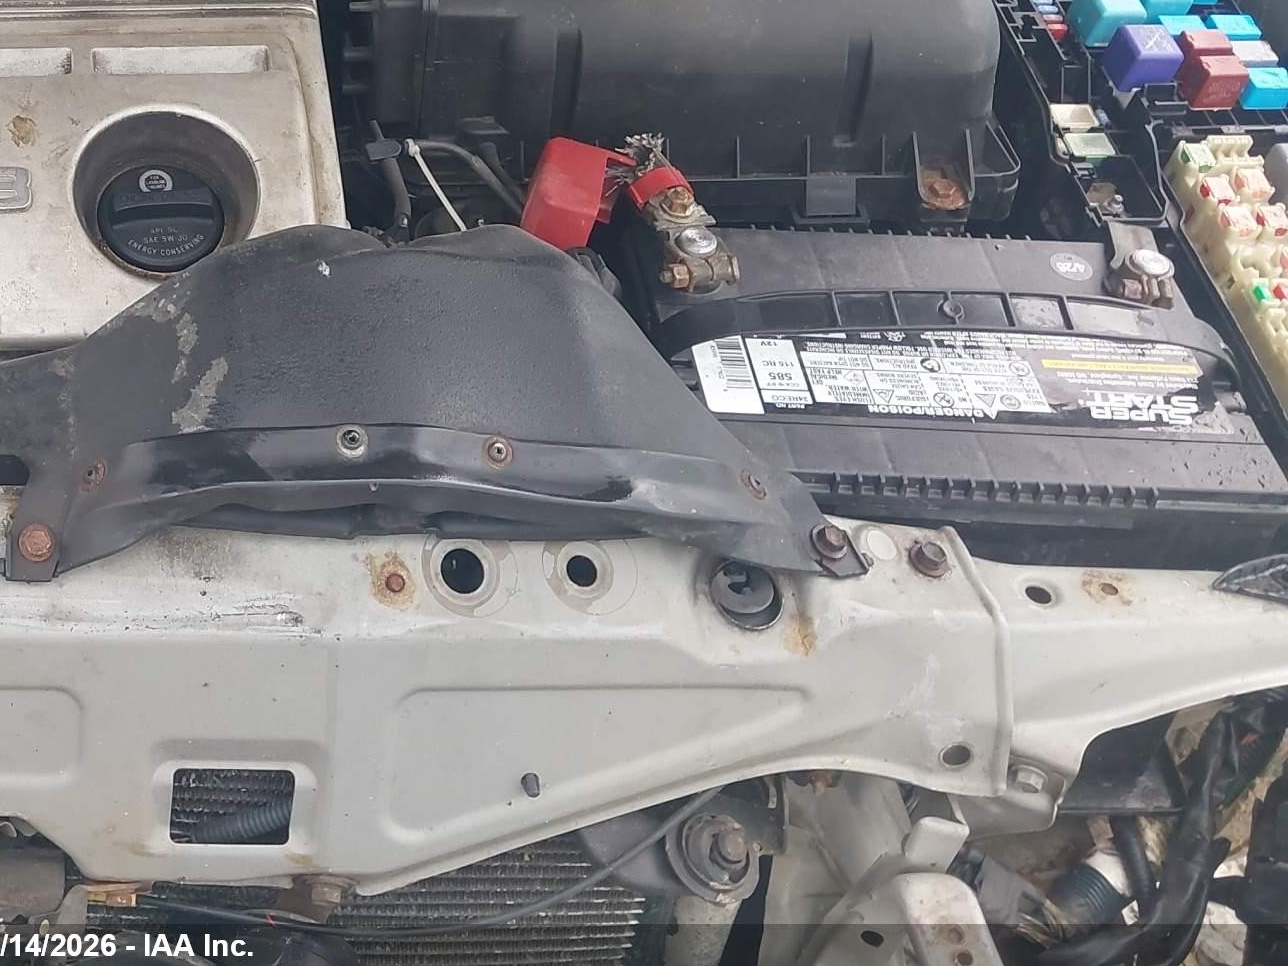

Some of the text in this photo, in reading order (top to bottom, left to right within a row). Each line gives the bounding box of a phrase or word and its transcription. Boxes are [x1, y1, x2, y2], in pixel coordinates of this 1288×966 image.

[127, 234, 205, 256] ENERGY CONSERVING
[144, 235, 159, 244] SAE
[1086, 392, 1199, 416] START
[1090, 405, 1194, 425] SUPER
